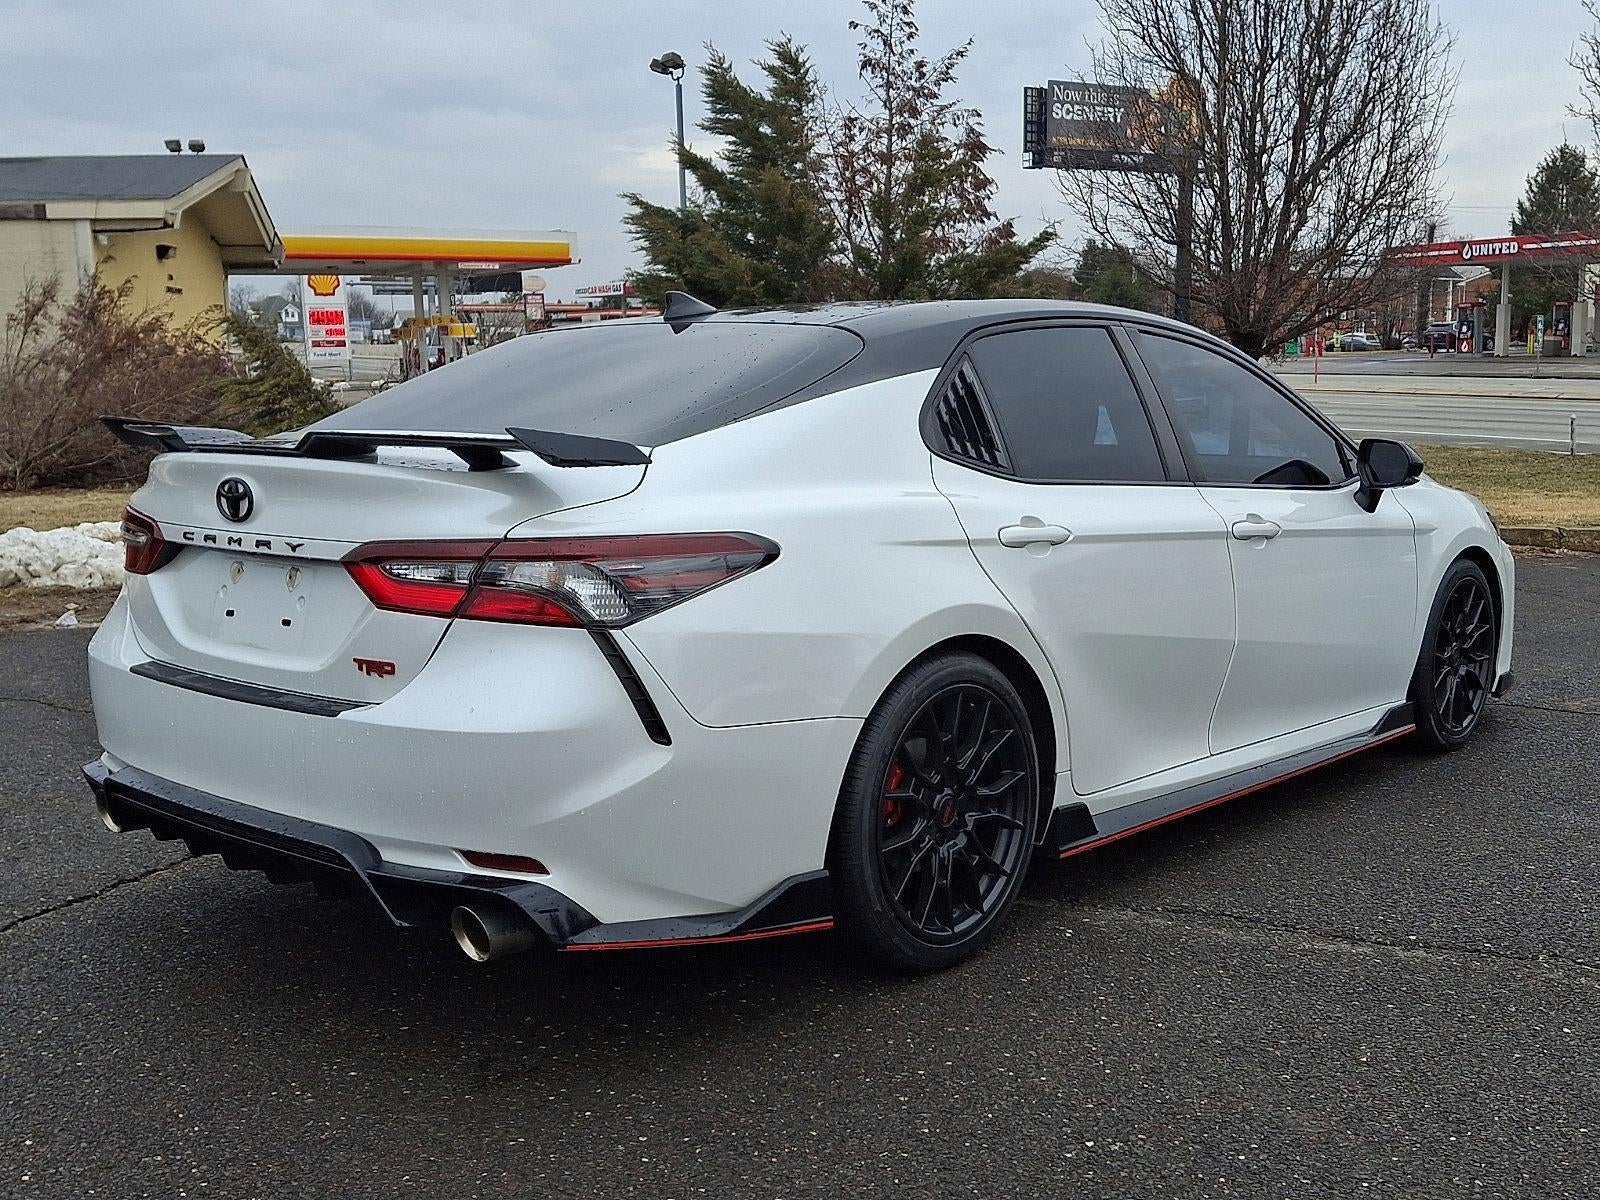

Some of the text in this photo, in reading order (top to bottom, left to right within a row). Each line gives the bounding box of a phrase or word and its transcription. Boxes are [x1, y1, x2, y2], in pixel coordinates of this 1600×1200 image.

[1053, 85, 1082, 102] Now
[1085, 88, 1107, 104] this
[1052, 103, 1124, 123] SCENERY
[1472, 242, 1518, 256] UNITED
[588, 286, 598, 295] CAR
[598, 284, 611, 294] WASH
[612, 283, 622, 293] GAS
[182, 531, 305, 553] CAMRY
[352, 657, 396, 678] TRD
